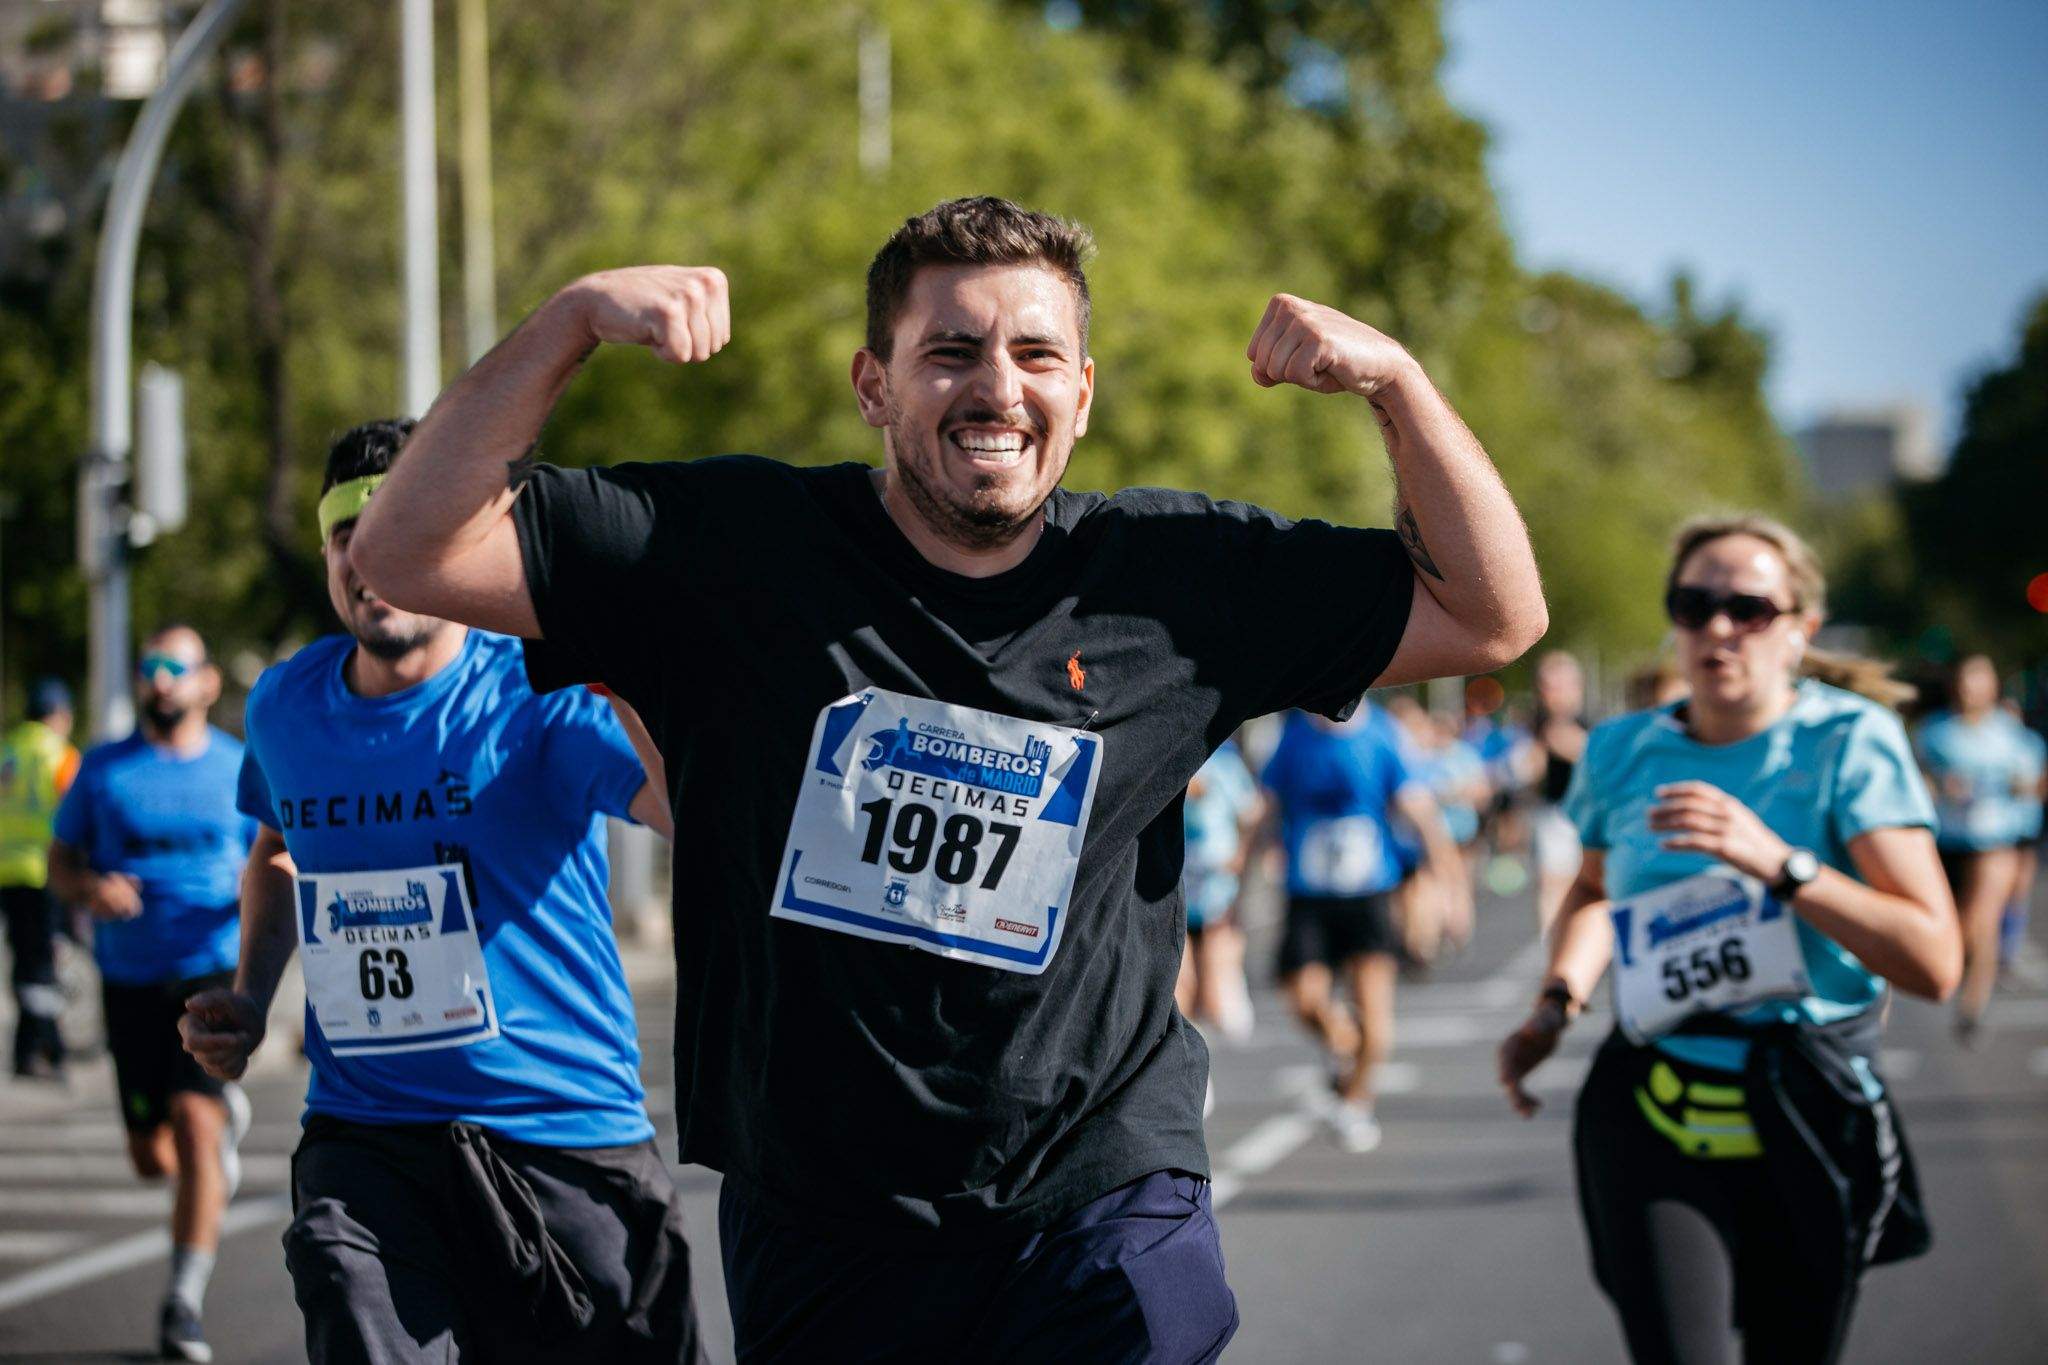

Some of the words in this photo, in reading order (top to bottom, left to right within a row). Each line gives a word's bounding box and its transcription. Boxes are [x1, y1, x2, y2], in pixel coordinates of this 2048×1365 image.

[918, 722, 966, 741] CARRERA
[912, 734, 1043, 777] BOMBEROS
[888, 771, 1029, 817] DECIMAS
[957, 764, 976, 782] de
[980, 769, 1039, 796] MADRID
[280, 784, 473, 829] DECIMAS
[860, 796, 1023, 892] 1987
[347, 894, 426, 913] BOMBEROS
[345, 924, 430, 944] DECIMAS
[359, 947, 414, 1001] 63
[1662, 937, 1751, 1000] 556
